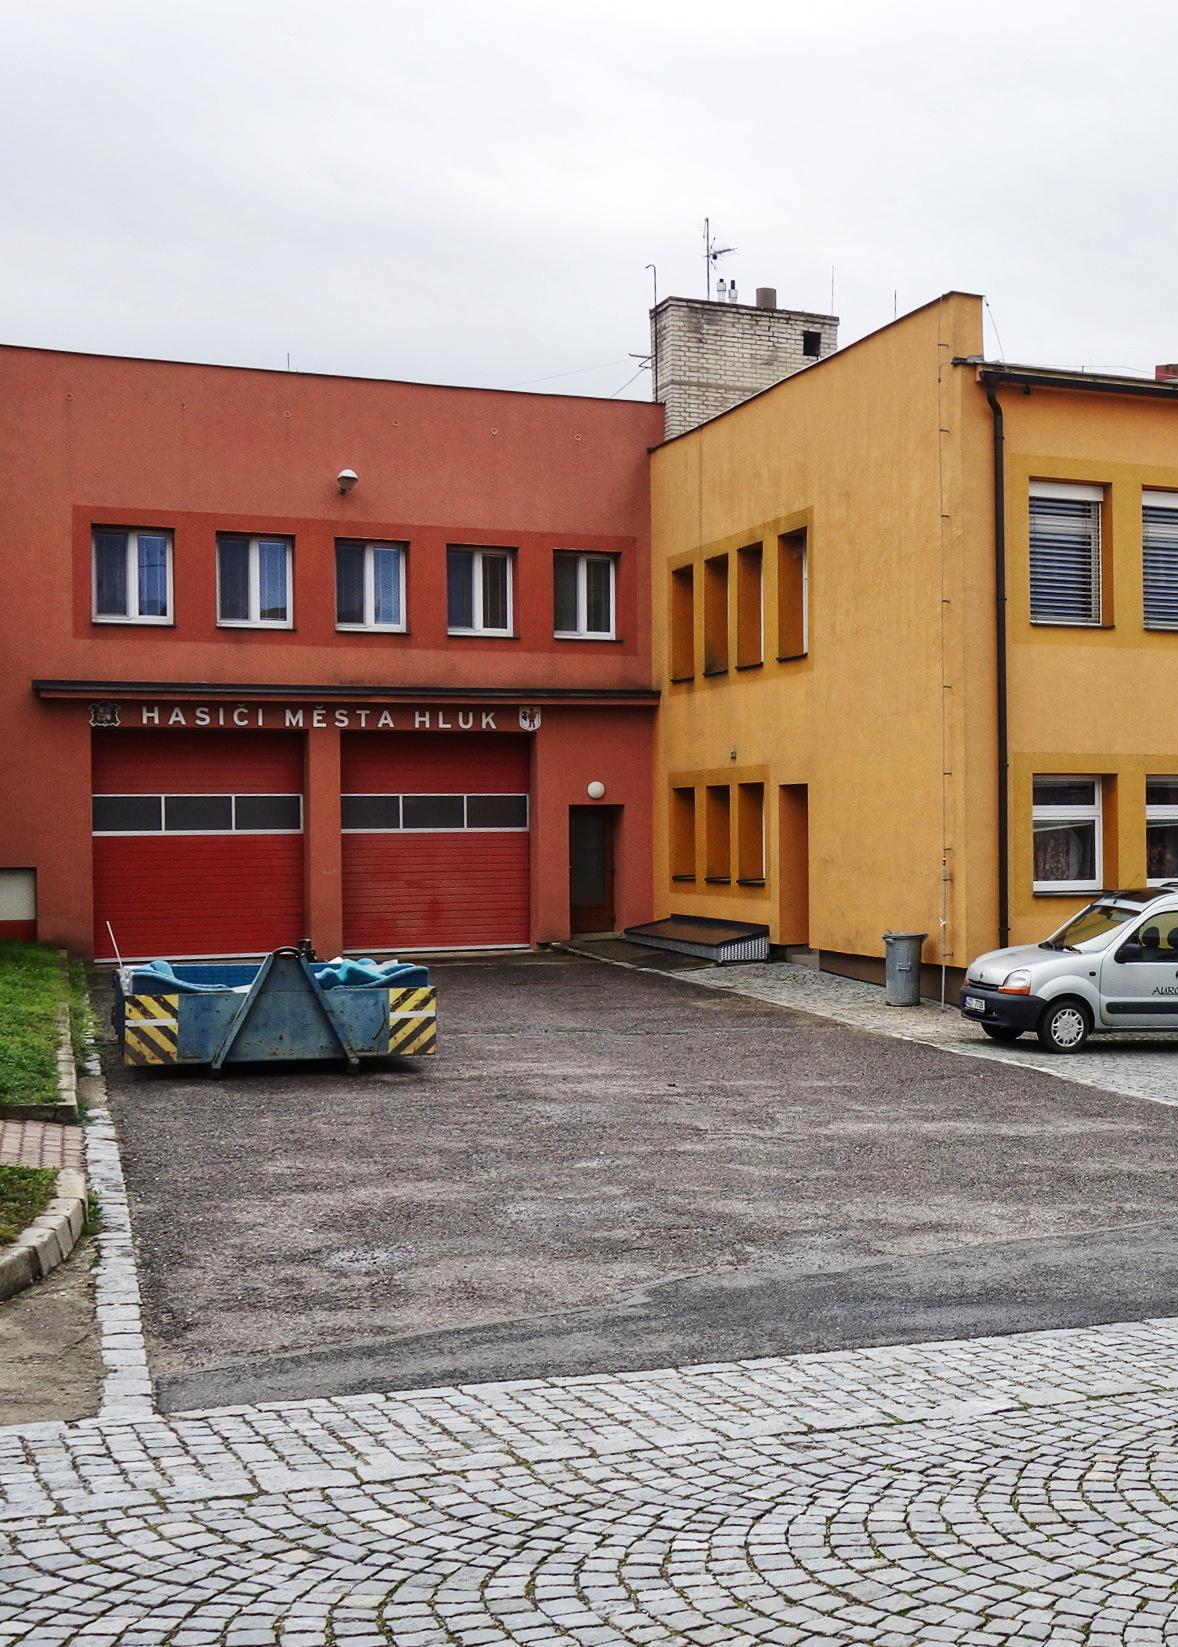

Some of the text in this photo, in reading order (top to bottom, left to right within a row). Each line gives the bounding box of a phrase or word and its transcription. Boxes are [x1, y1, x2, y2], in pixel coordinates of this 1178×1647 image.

[142, 704, 497, 730] HASIČI MĚSTA HLUK
